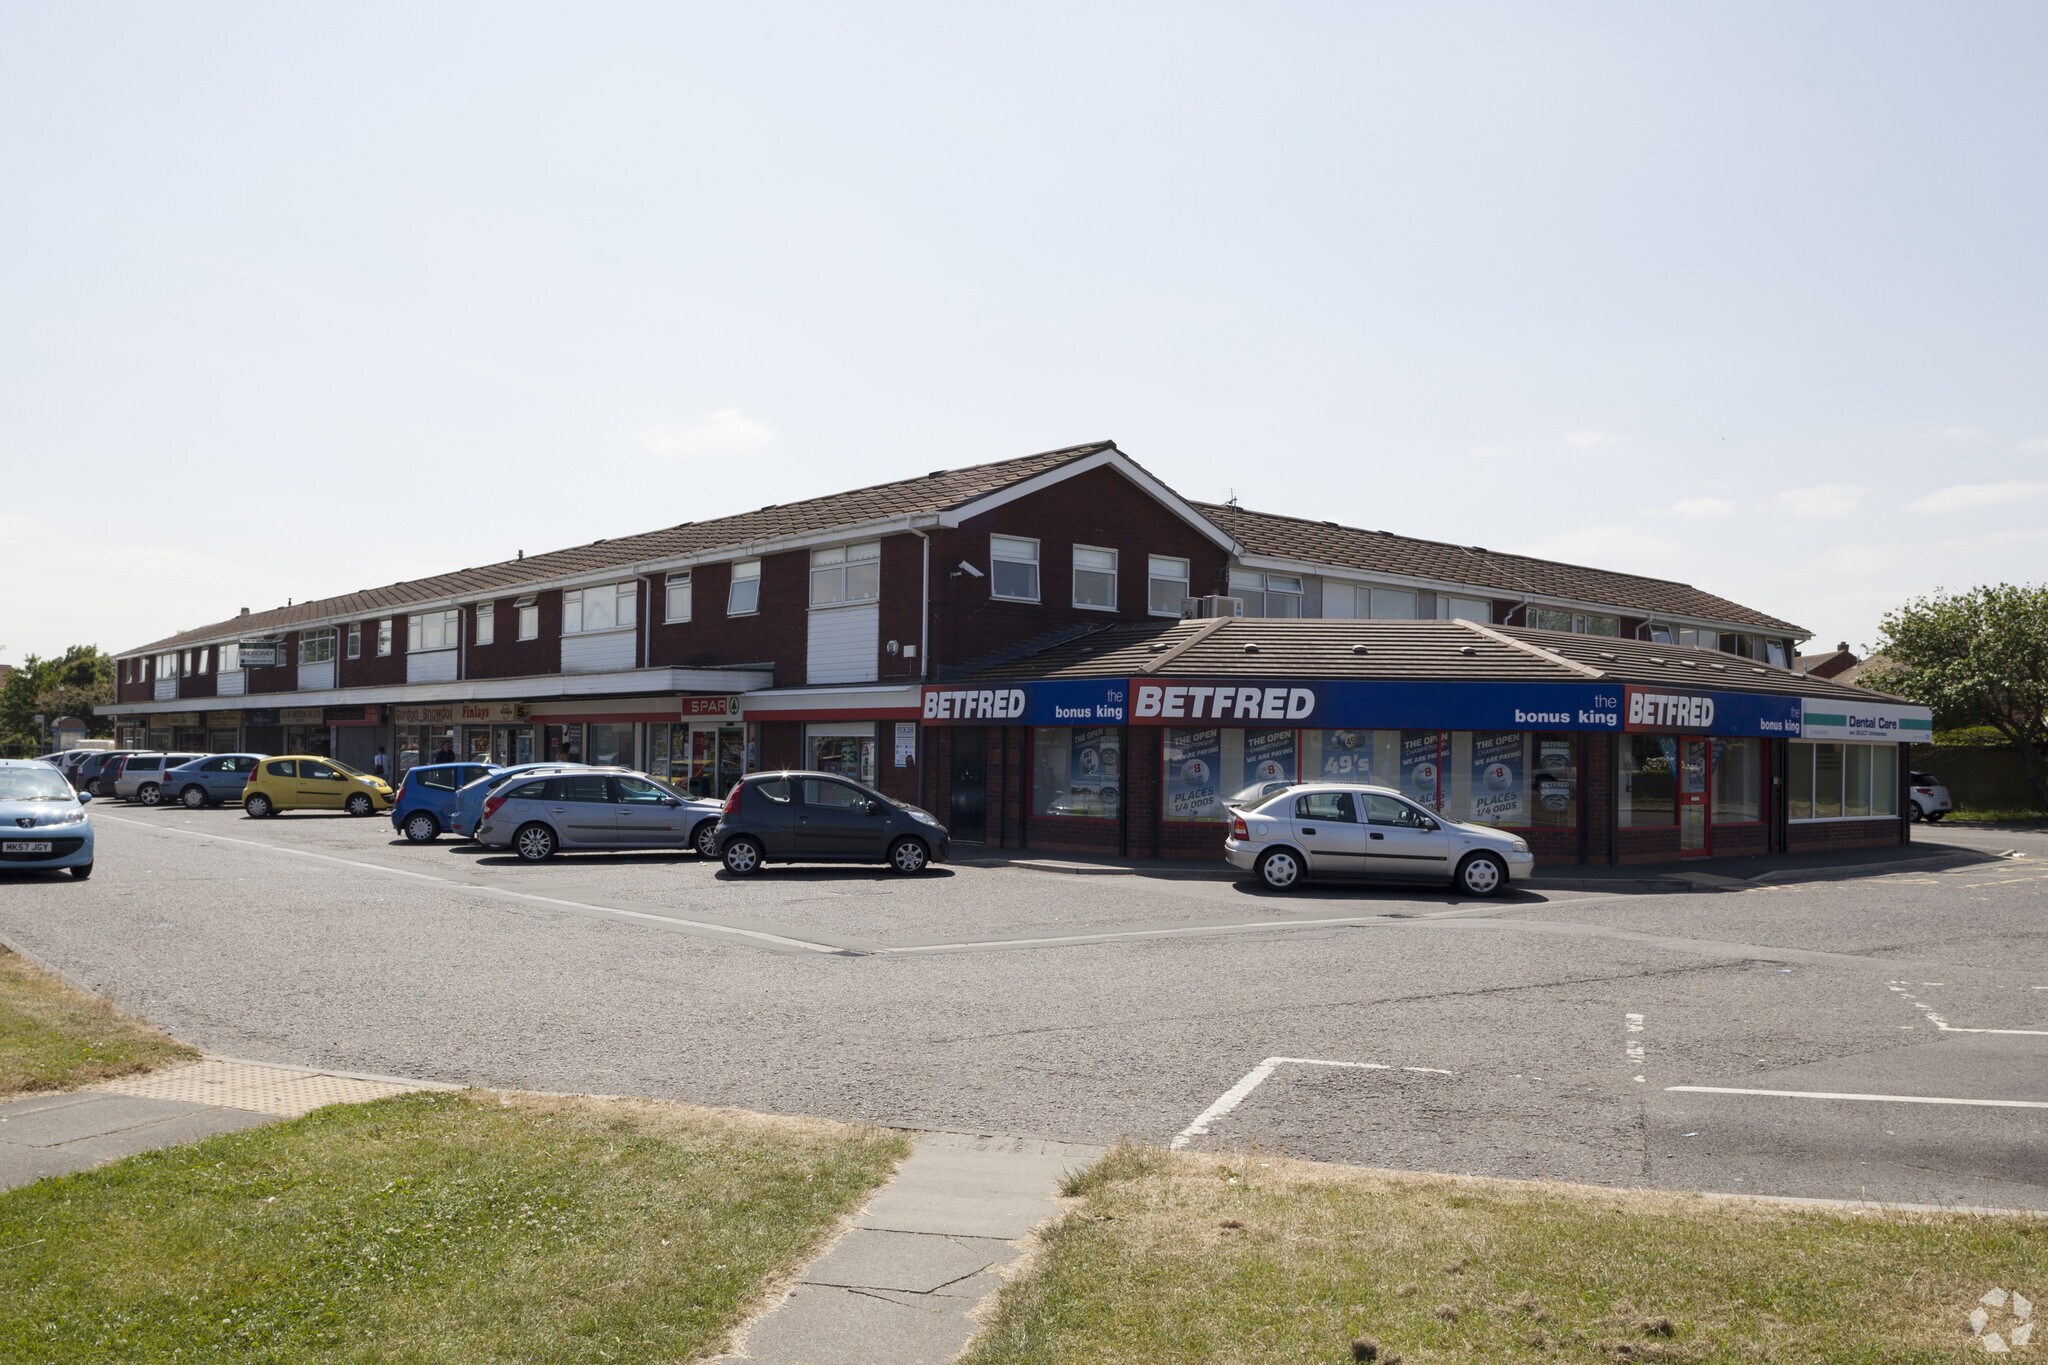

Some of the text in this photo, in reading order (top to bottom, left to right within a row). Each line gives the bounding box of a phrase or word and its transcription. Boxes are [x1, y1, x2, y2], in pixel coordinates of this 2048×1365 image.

[1107, 688, 1123, 702] the
[1135, 685, 1315, 719] BETFRED
[1594, 694, 1617, 708] the
[691, 700, 727, 713] SPAR
[923, 688, 1026, 719] BETFRED
[1629, 692, 1714, 727] BETFRED
[462, 705, 490, 719] Finlays
[1055, 705, 1123, 720] bonus king
[1515, 709, 1617, 727] bonus king
[1791, 706, 1800, 719] the
[1760, 718, 1783, 731] bonus
[1785, 719, 1800, 733] king
[1849, 715, 1897, 730] Dental Care
[1074, 728, 1103, 744] THE OPEN
[1174, 729, 1217, 745] THE OPEN
[1248, 730, 1291, 747] THE OPEN
[1404, 733, 1448, 749] THE OPN
[1476, 733, 1520, 750] THE OPEN
[1197, 746, 1219, 757] PAYING
[1246, 755, 1256, 763] WE
[1271, 747, 1293, 758] PAYING
[1402, 749, 1450, 766] WE ARE PAYNG
[1474, 759, 1485, 767] WE
[1499, 750, 1522, 761] PAYING
[1194, 763, 1201, 773] 8
[1267, 764, 1275, 774] 8
[1324, 754, 1370, 774] 49's
[1424, 767, 1432, 777] 8
[1495, 767, 1503, 778] 8
[1174, 786, 1214, 803] PLACES
[1476, 791, 1517, 808] PLACES
[1175, 797, 1214, 812] 1/4 ODDS
[1477, 801, 1517, 817] 1/4 ODDS
[6, 842, 48, 851] MK57 JGY
